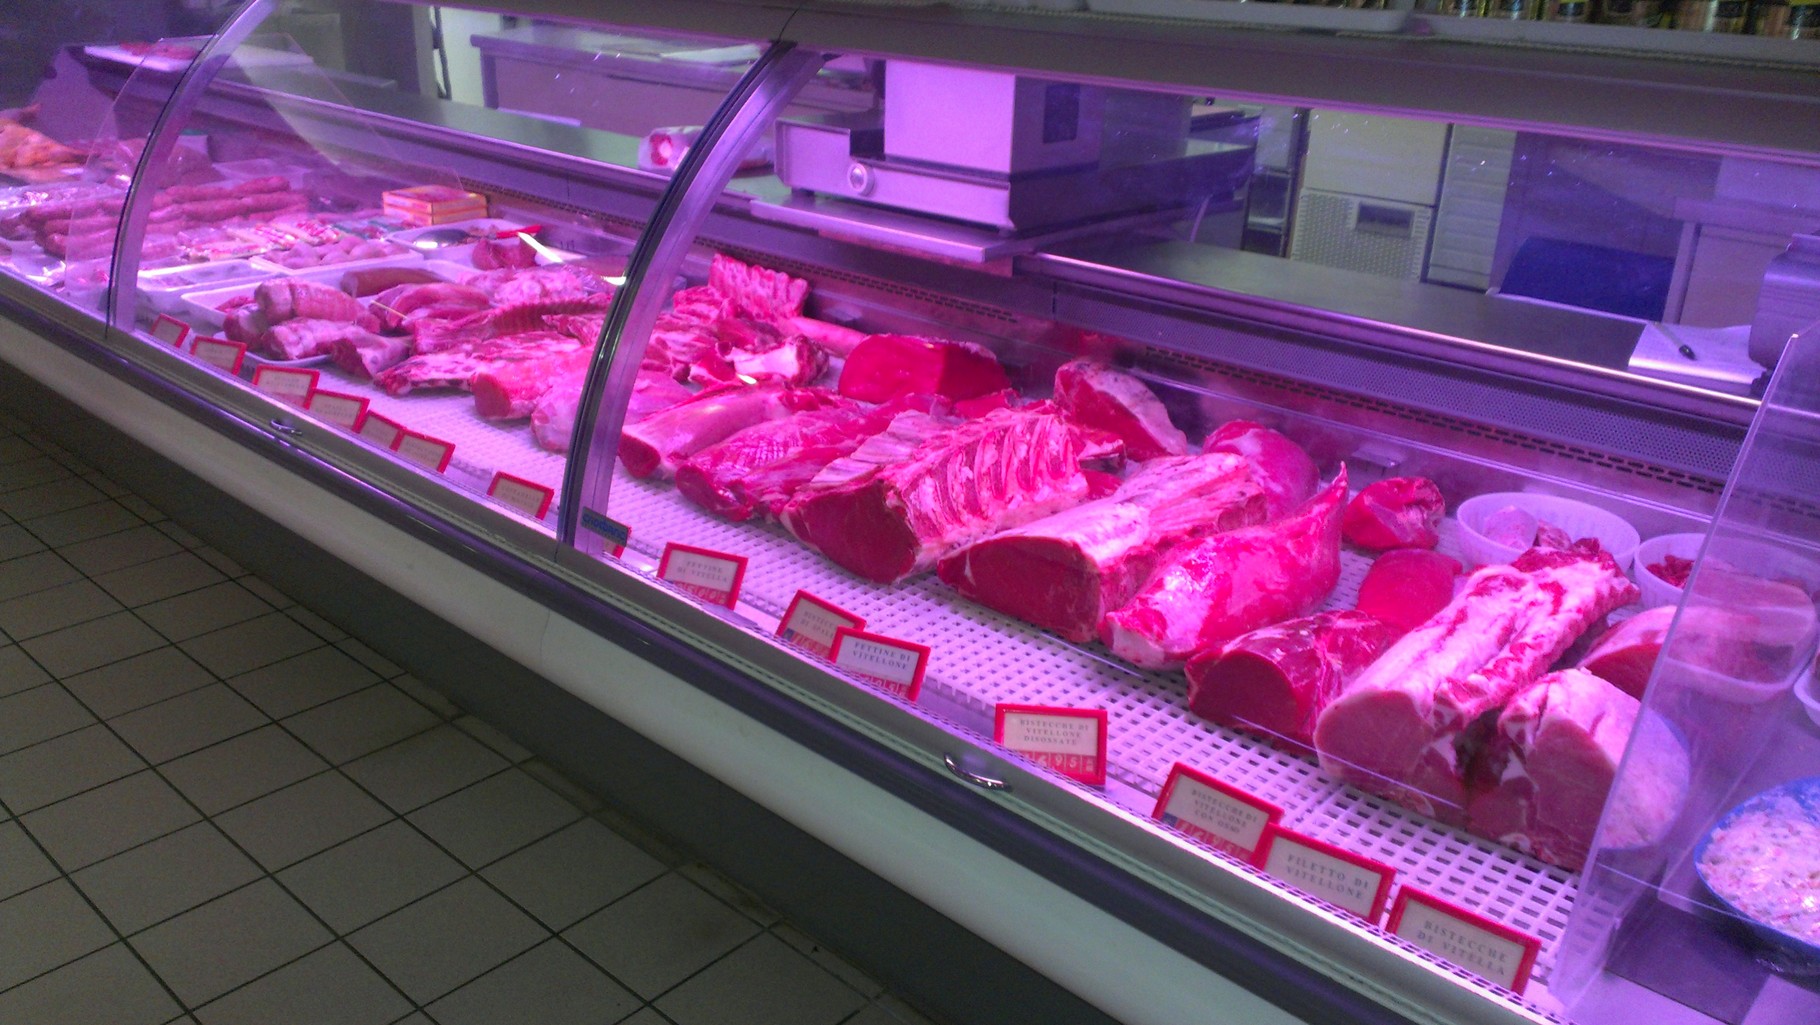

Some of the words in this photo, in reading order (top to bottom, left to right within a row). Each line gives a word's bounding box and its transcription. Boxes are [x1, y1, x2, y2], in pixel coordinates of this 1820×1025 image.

[852, 650, 907, 670] VITELLONE
[854, 641, 895, 658] FETTINE
[900, 653, 911, 662] DI
[1020, 719, 1074, 730] BISTECCHE
[1026, 727, 1081, 738] VITELLONE
[1024, 735, 1077, 745] DISOSSATE
[1192, 789, 1243, 816] BISTECCHE
[1246, 812, 1258, 823] DI
[1195, 799, 1247, 828] VITELLONE
[1194, 809, 1213, 822] CON
[1219, 820, 1241, 834] OSSO
[1286, 866, 1362, 899] VITELLONE
[1288, 854, 1345, 880] FILETTO
[1354, 877, 1369, 889] DI
[1417, 930, 1433, 944] DI
[1443, 941, 1505, 975] VITELLA
[1424, 920, 1507, 962] BISTECCHE
